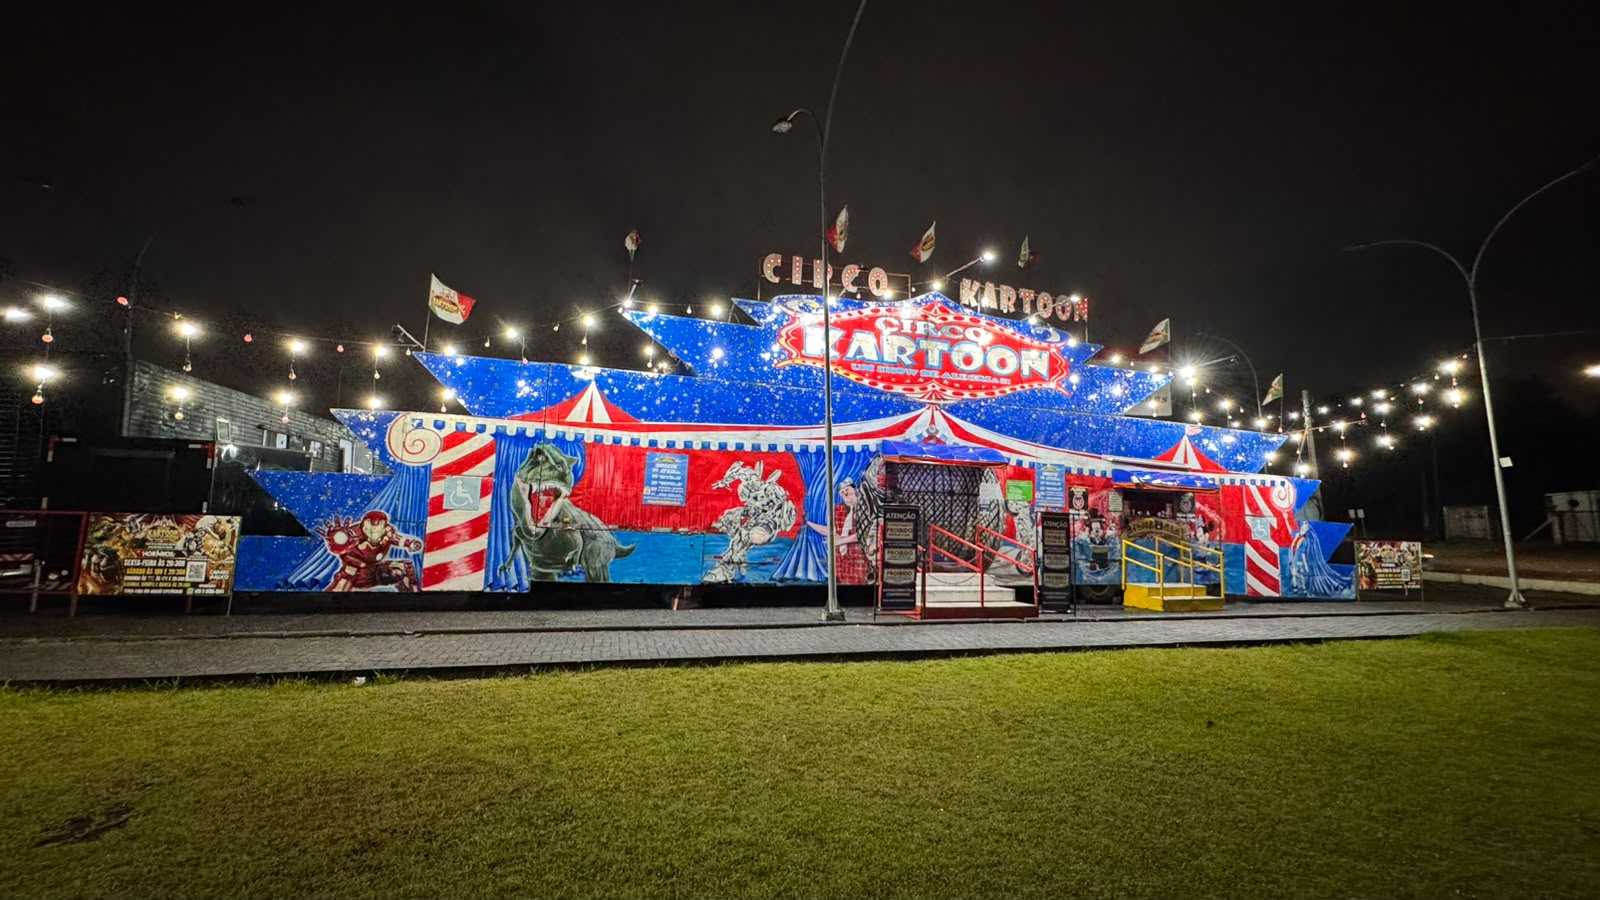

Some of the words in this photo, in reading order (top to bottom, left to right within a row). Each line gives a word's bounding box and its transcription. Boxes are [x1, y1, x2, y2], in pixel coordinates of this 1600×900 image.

[960, 278, 1089, 322] KARTOON
[875, 316, 989, 344] CIRCO
[803, 324, 1050, 380] KARTOON
[885, 512, 916, 521] ATENÇÃO
